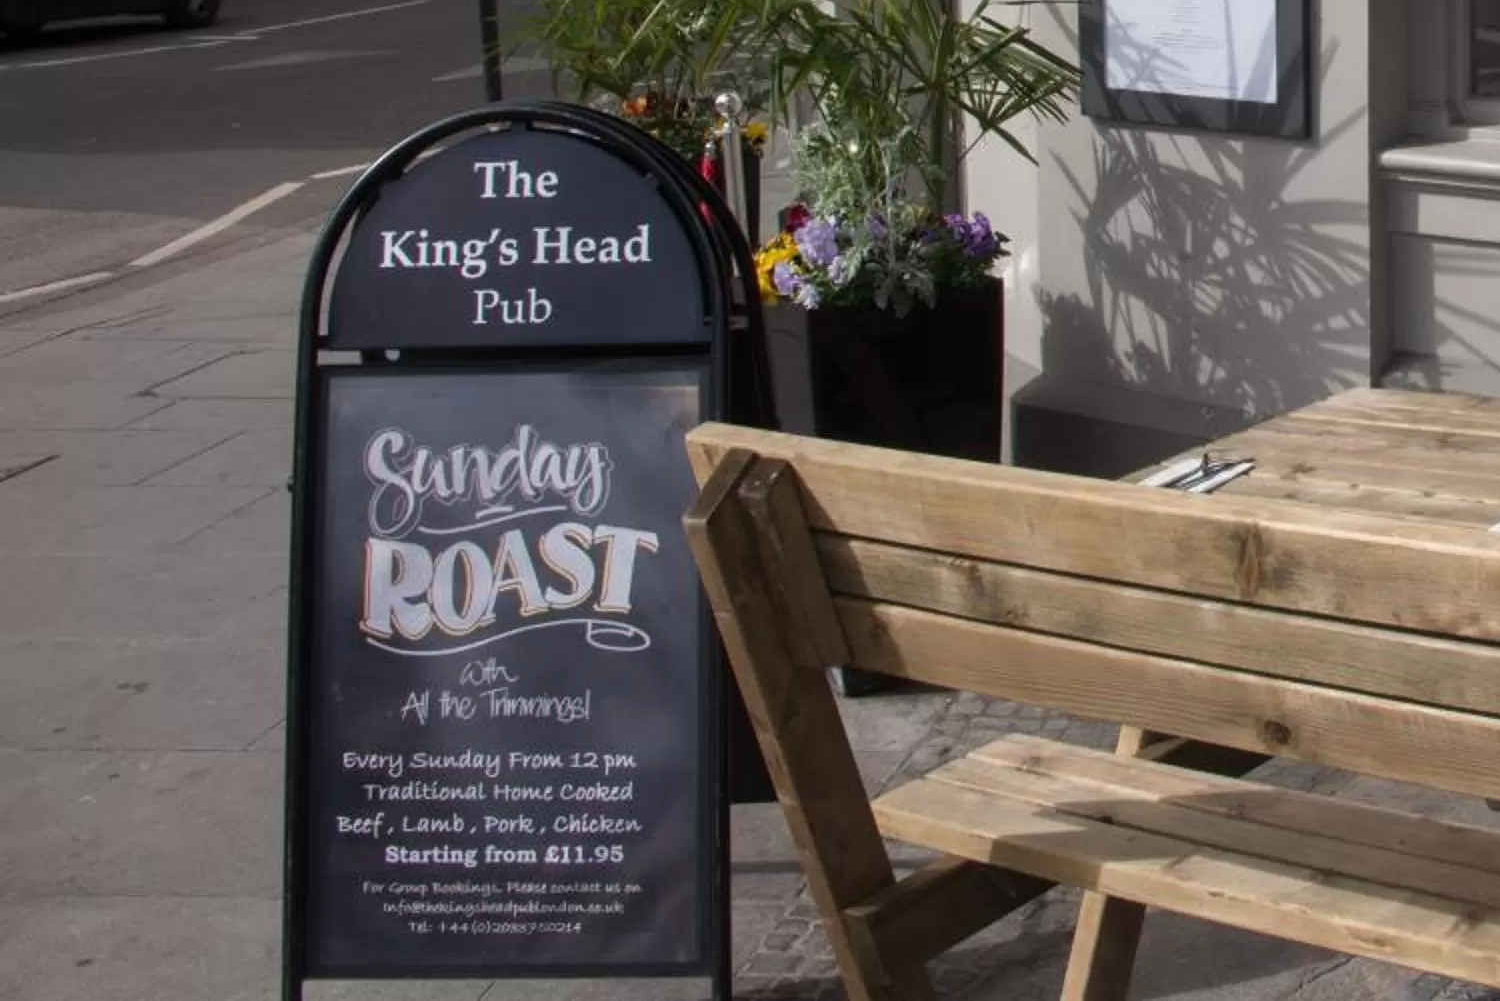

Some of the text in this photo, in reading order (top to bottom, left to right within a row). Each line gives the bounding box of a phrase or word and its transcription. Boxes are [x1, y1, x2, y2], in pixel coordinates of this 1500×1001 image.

[474, 160, 559, 198] The
[379, 224, 651, 279] King's Head
[473, 289, 552, 324] Pub
[364, 425, 614, 536] Sunday
[360, 522, 659, 640] ROAST
[402, 687, 592, 725] All the Trimmings!
[343, 752, 404, 778] Every
[409, 750, 501, 778] Sunday
[508, 751, 563, 769] From
[363, 781, 633, 801] Traditional Home Cooked
[553, 813, 643, 834] Chicken
[384, 844, 624, 867] Starting from £11.95
[362, 880, 385, 893] For
[388, 880, 429, 899] Group
[506, 880, 547, 894] Please
[550, 881, 601, 894] contact
[605, 882, 621, 893] us
[623, 883, 643, 894] on
